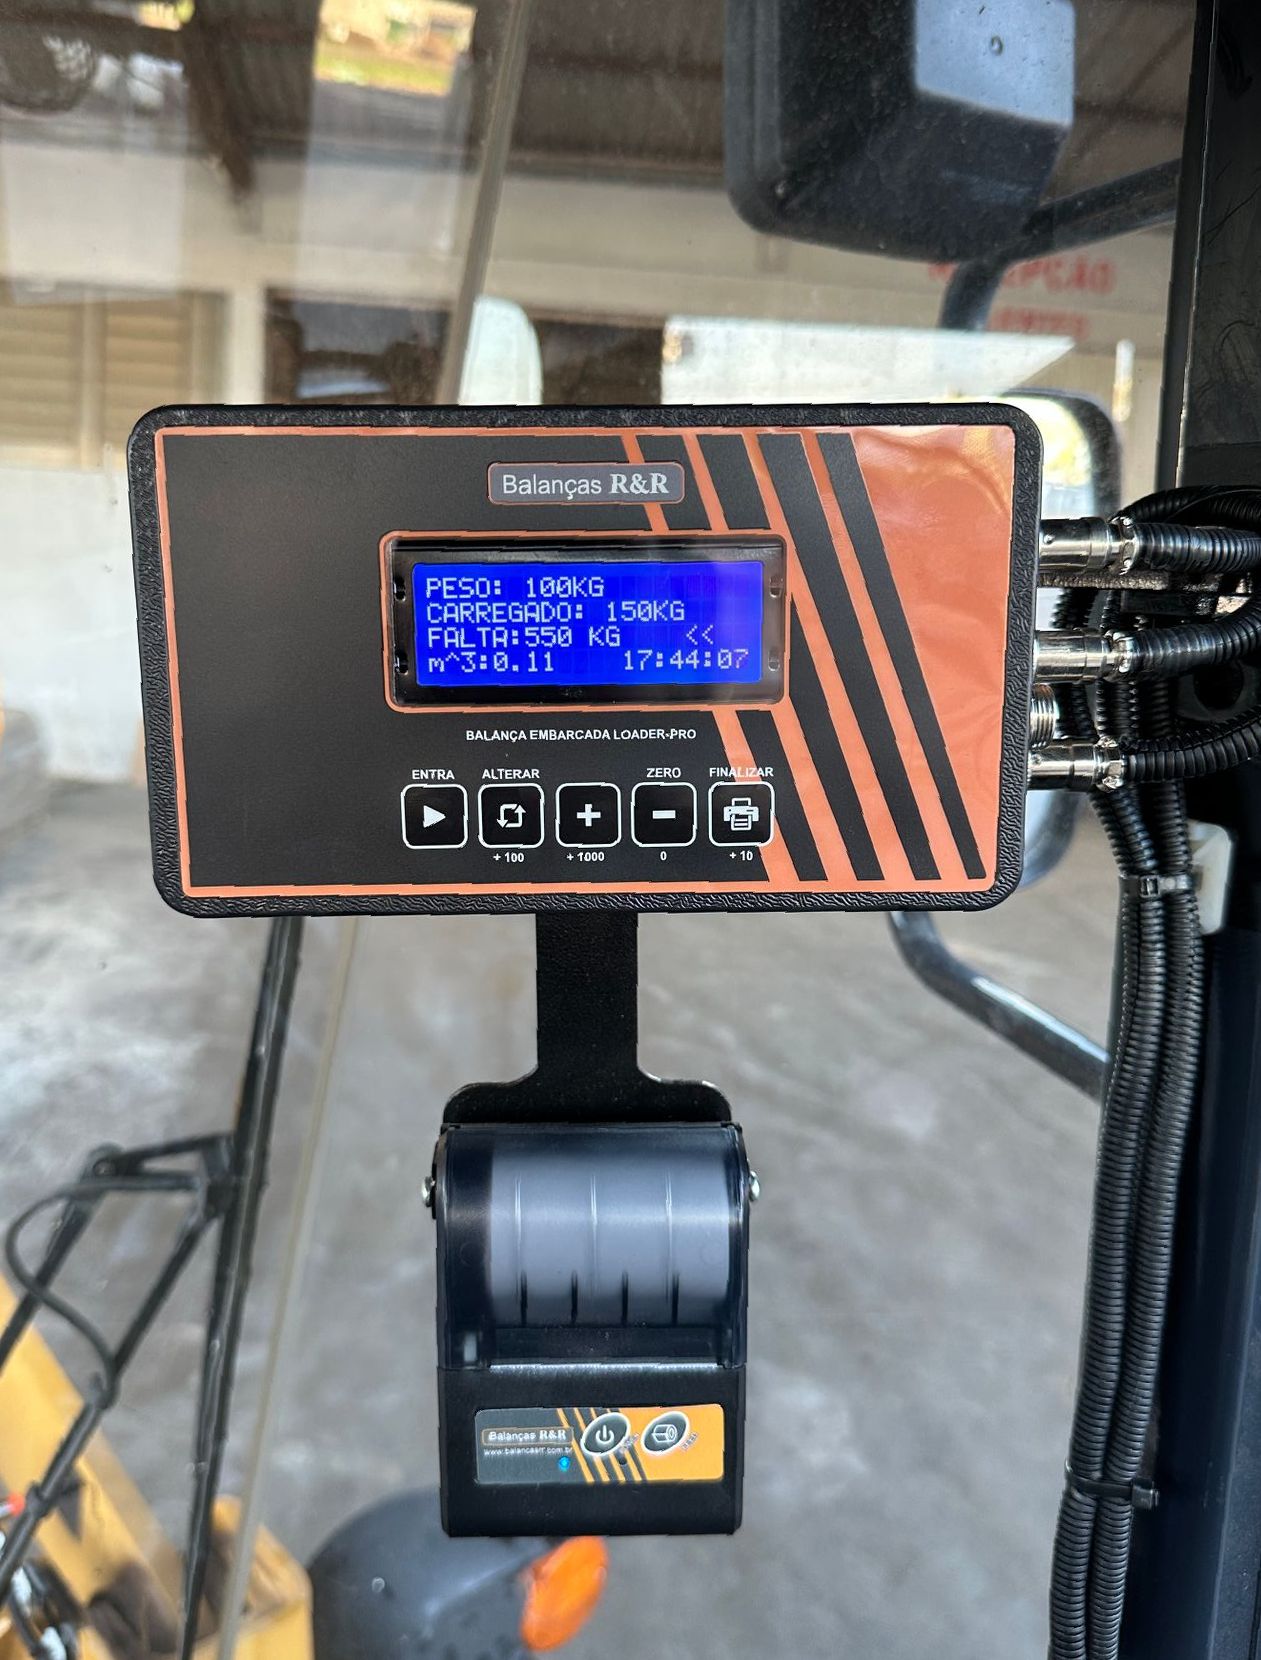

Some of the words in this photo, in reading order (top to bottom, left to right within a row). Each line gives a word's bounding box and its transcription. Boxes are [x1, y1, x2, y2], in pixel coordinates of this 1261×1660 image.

[502, 474, 602, 500] Balanças
[609, 472, 669, 495] R&R
[426, 577, 502, 599] PESO:
[526, 577, 605, 599] 100KG
[426, 602, 583, 624] CARREGADO:
[607, 601, 685, 623] 150KG
[589, 626, 621, 648] KG
[428, 651, 554, 673] m^3:0.11
[624, 649, 749, 671] 17:44:07
[466, 730, 527, 743] BALANÇA
[529, 729, 611, 741] EMBARCADA
[613, 728, 697, 741] LOADER-PRO
[411, 769, 455, 780] ENTRA
[482, 768, 541, 780] ALTERAR
[646, 767, 682, 778] ZERO
[708, 766, 774, 778] FINALIZAR
[660, 850, 667, 861] 0
[488, 1431, 536, 1442] Balanças
[539, 1429, 567, 1440] R&R
